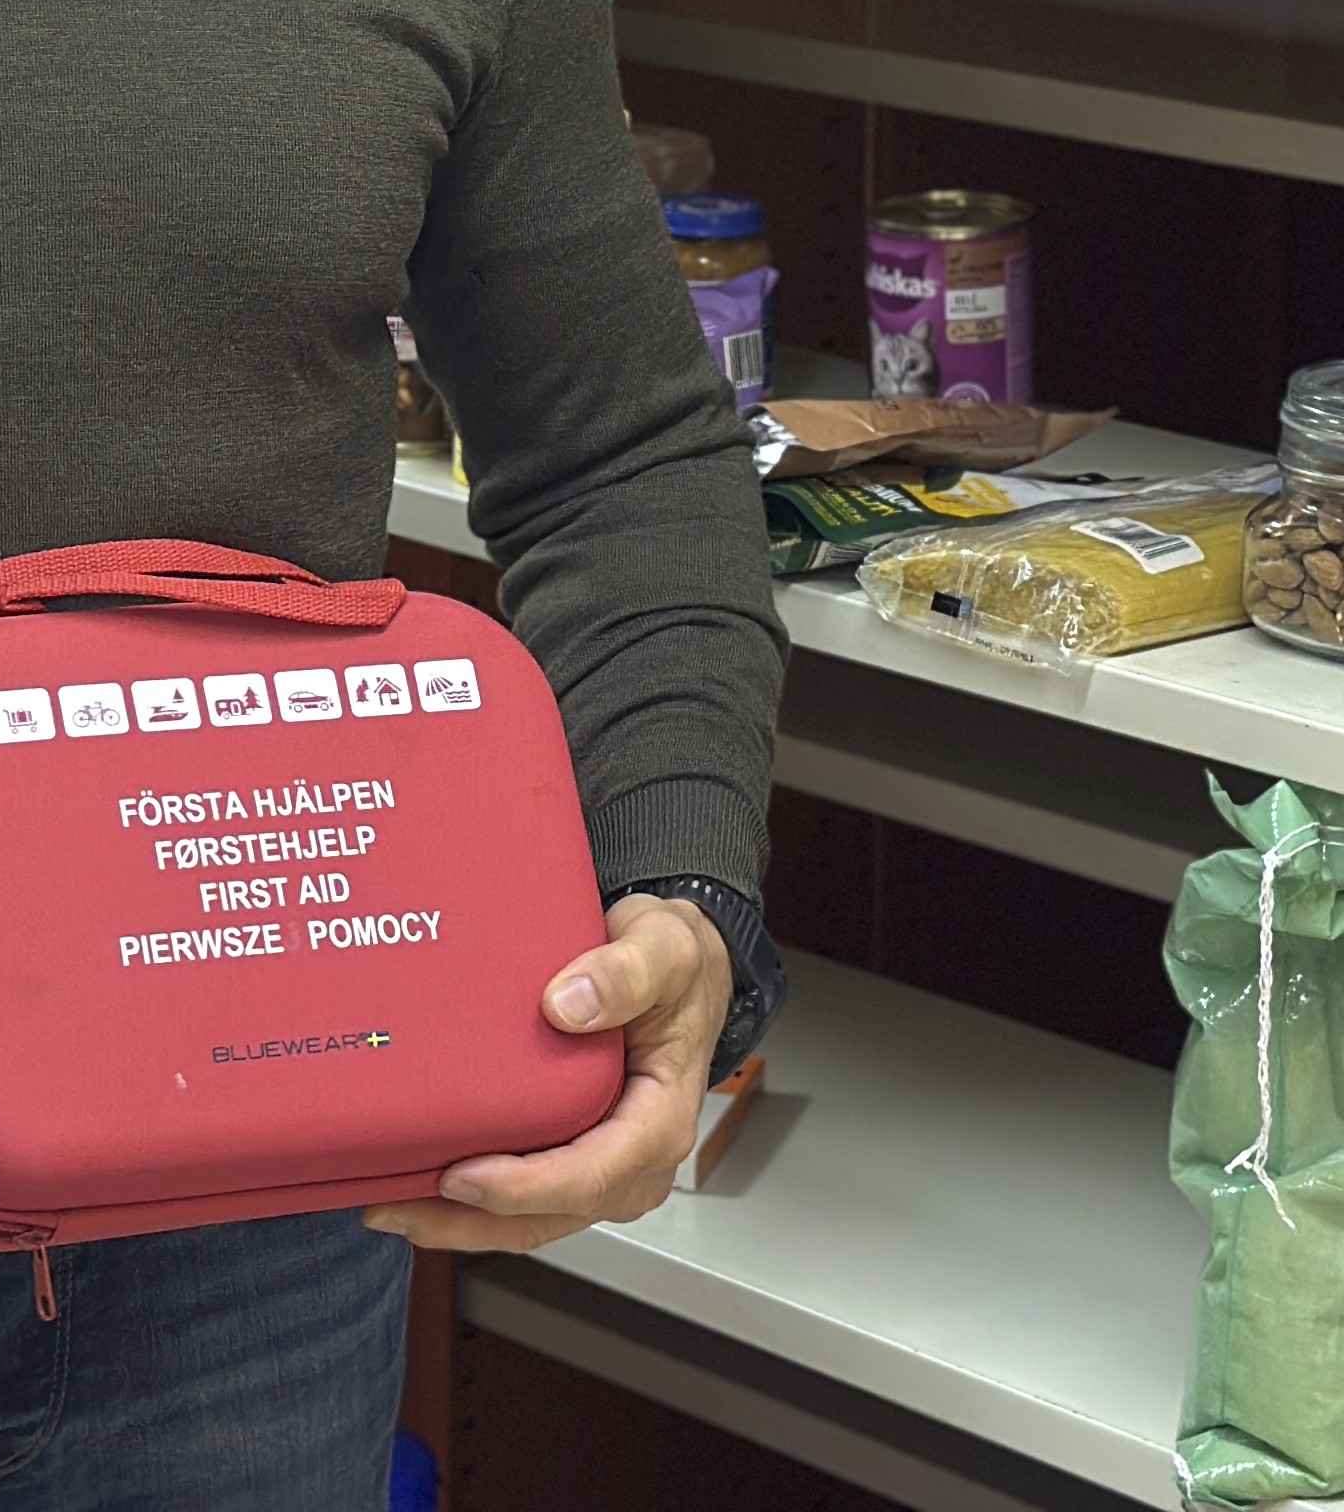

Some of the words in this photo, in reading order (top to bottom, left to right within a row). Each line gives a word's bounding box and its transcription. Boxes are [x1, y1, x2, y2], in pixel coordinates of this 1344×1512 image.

[118, 789, 249, 828] FÖRSTA
[253, 778, 395, 818] HJÄLPEN
[154, 825, 376, 871] FØRSTEHJELP
[199, 876, 289, 913] FIRST
[298, 872, 351, 905] AID
[118, 923, 285, 967] PIERWSZE
[306, 910, 441, 951] POMOCY
[211, 1033, 360, 1064] BLUEWEAR
